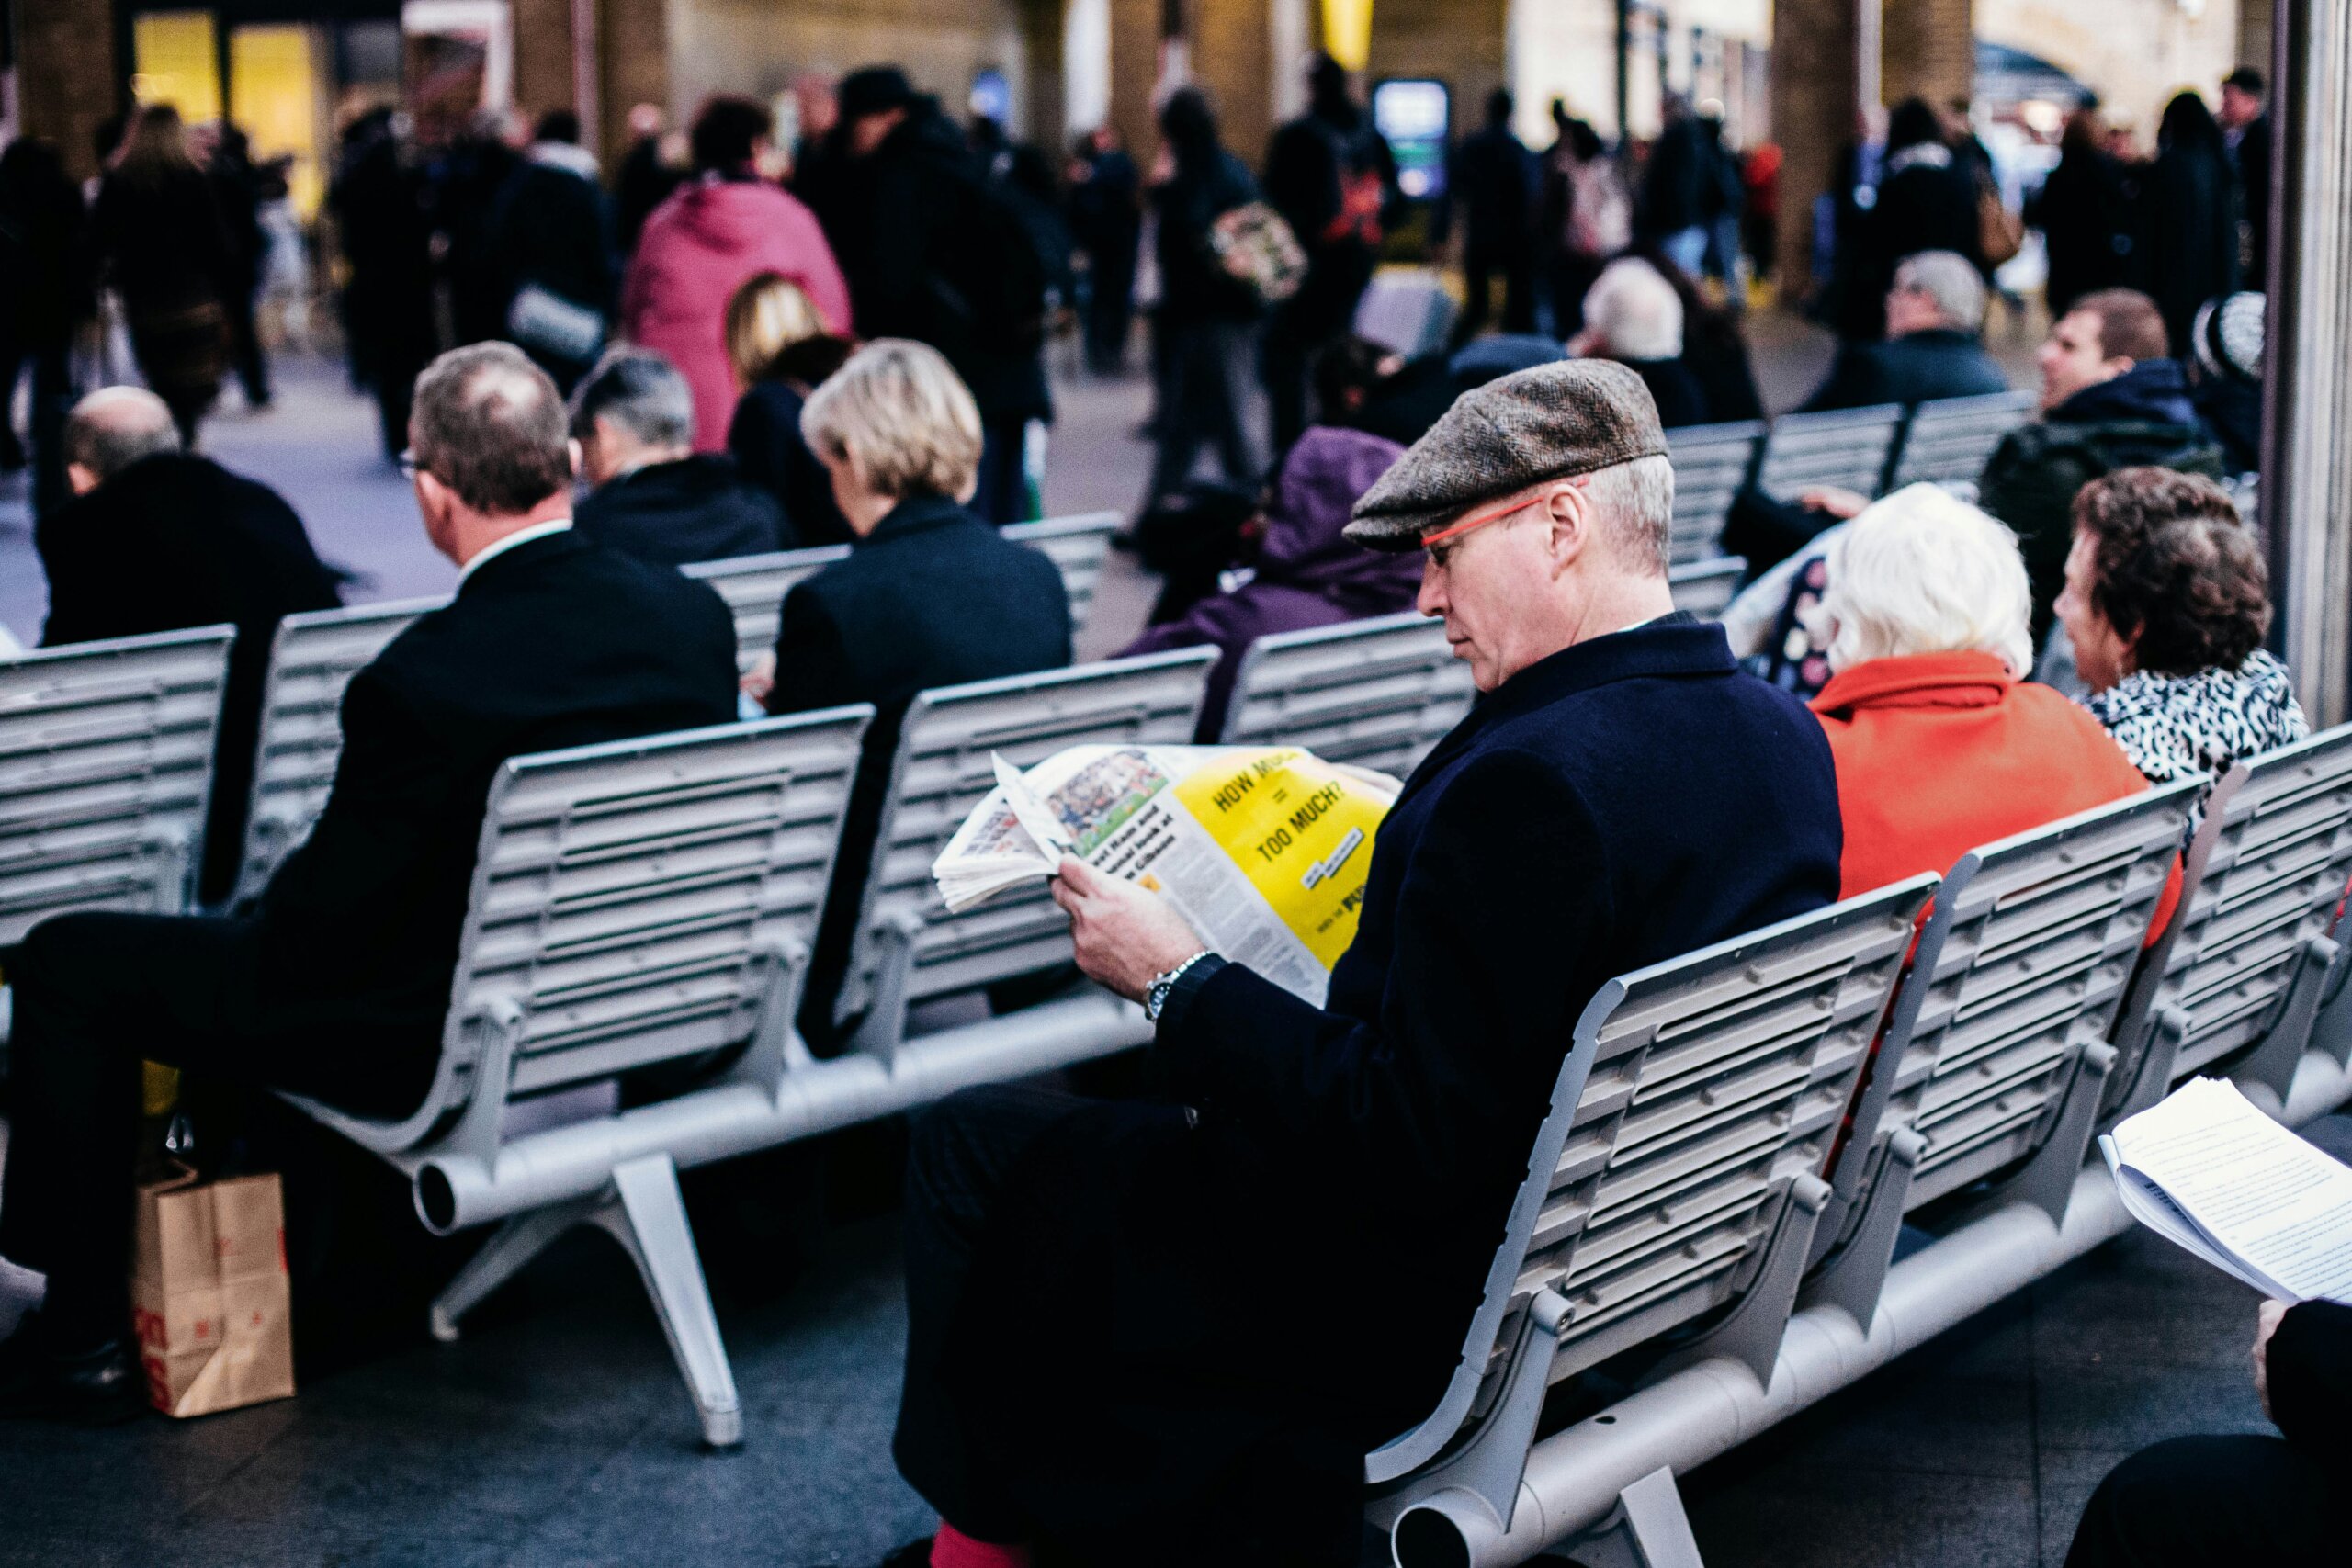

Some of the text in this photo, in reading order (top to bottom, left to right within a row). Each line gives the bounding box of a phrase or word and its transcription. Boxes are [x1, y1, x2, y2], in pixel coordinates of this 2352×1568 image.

[1212, 771, 1255, 813] HOW
[1138, 804, 1159, 826] and
[1257, 828, 1293, 862] TOO
[1289, 781, 1346, 834] MUCH?
